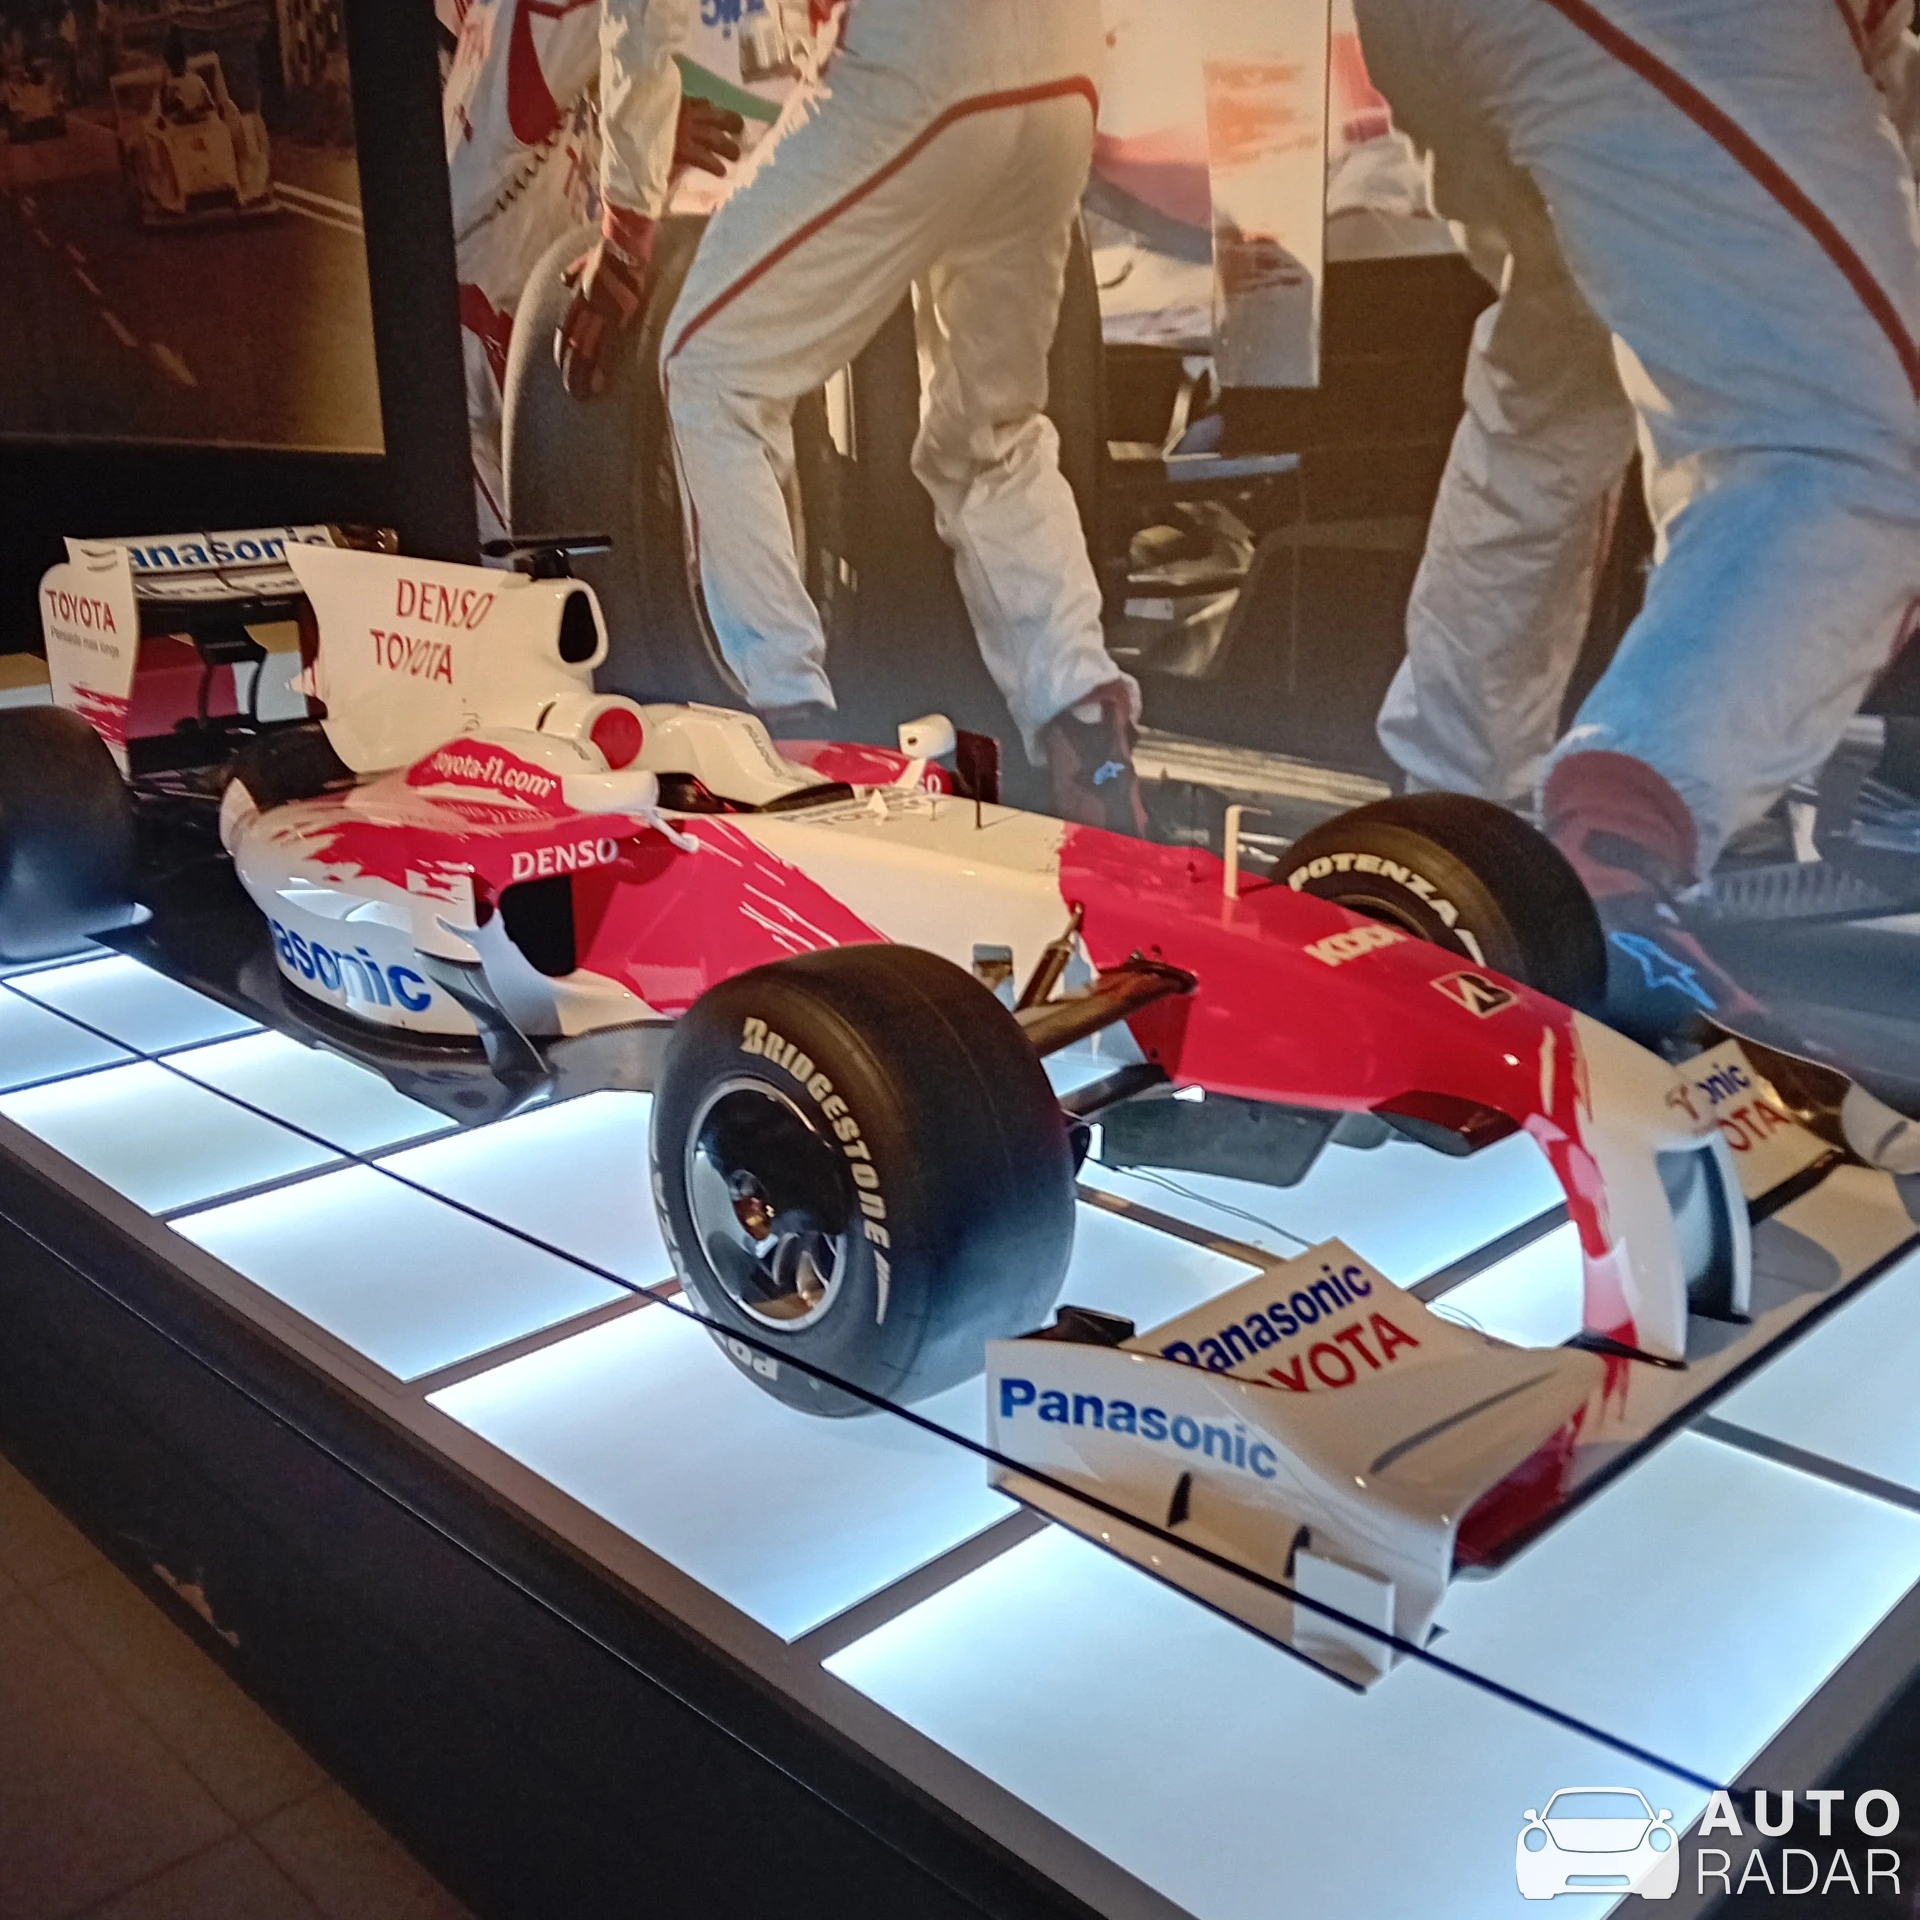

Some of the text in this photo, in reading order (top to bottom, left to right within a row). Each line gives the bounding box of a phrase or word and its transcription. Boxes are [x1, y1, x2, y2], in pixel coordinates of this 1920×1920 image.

[45, 589, 117, 634] TOYOTA
[396, 578, 494, 630] DENSO
[369, 628, 453, 685] TOYOTA
[511, 838, 618, 881] DENSO
[1288, 853, 1460, 928] POTENZA
[741, 1016, 890, 1250] BRIDGESTONE
[1255, 1313, 1420, 1392] YOTA
[1000, 1377, 1278, 1479] Panasonic
